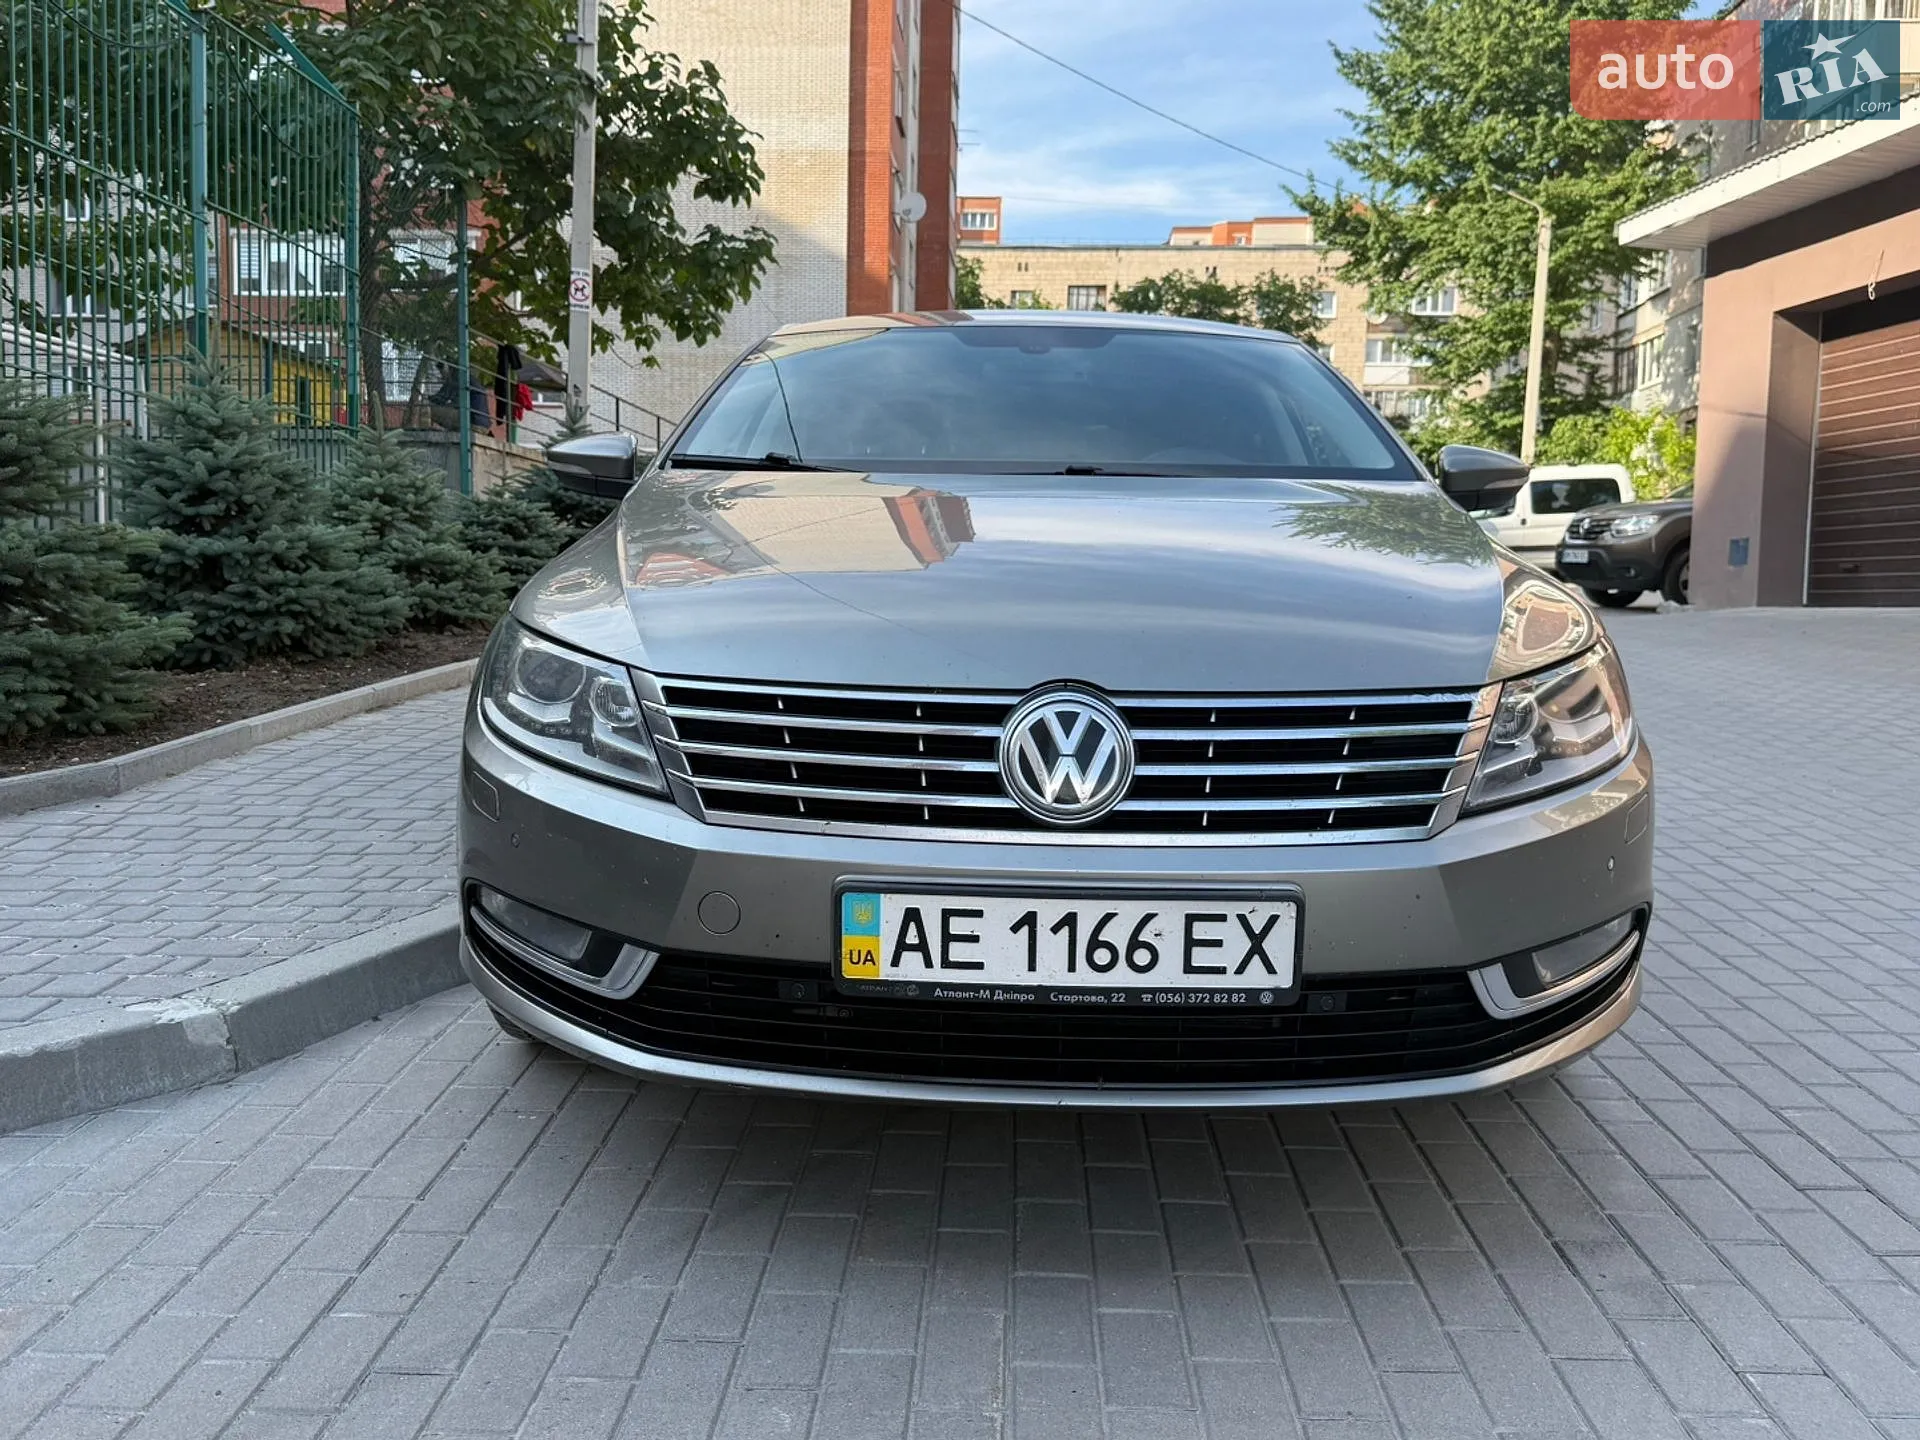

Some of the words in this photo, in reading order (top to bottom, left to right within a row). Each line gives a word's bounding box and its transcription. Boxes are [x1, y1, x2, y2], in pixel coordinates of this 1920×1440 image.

[890, 907, 985, 970] AE
[1008, 911, 1159, 973] 1166
[1182, 913, 1281, 975] EX
[849, 949, 876, 966] UA
[934, 988, 991, 999] Атлант-М
[993, 990, 1035, 1002] Дніпро
[1111, 993, 1126, 1003] 22
[1155, 992, 1185, 1004] (056)
[1188, 993, 1210, 1003] 372
[1213, 993, 1228, 1003] 82
[1231, 993, 1247, 1003] 82
